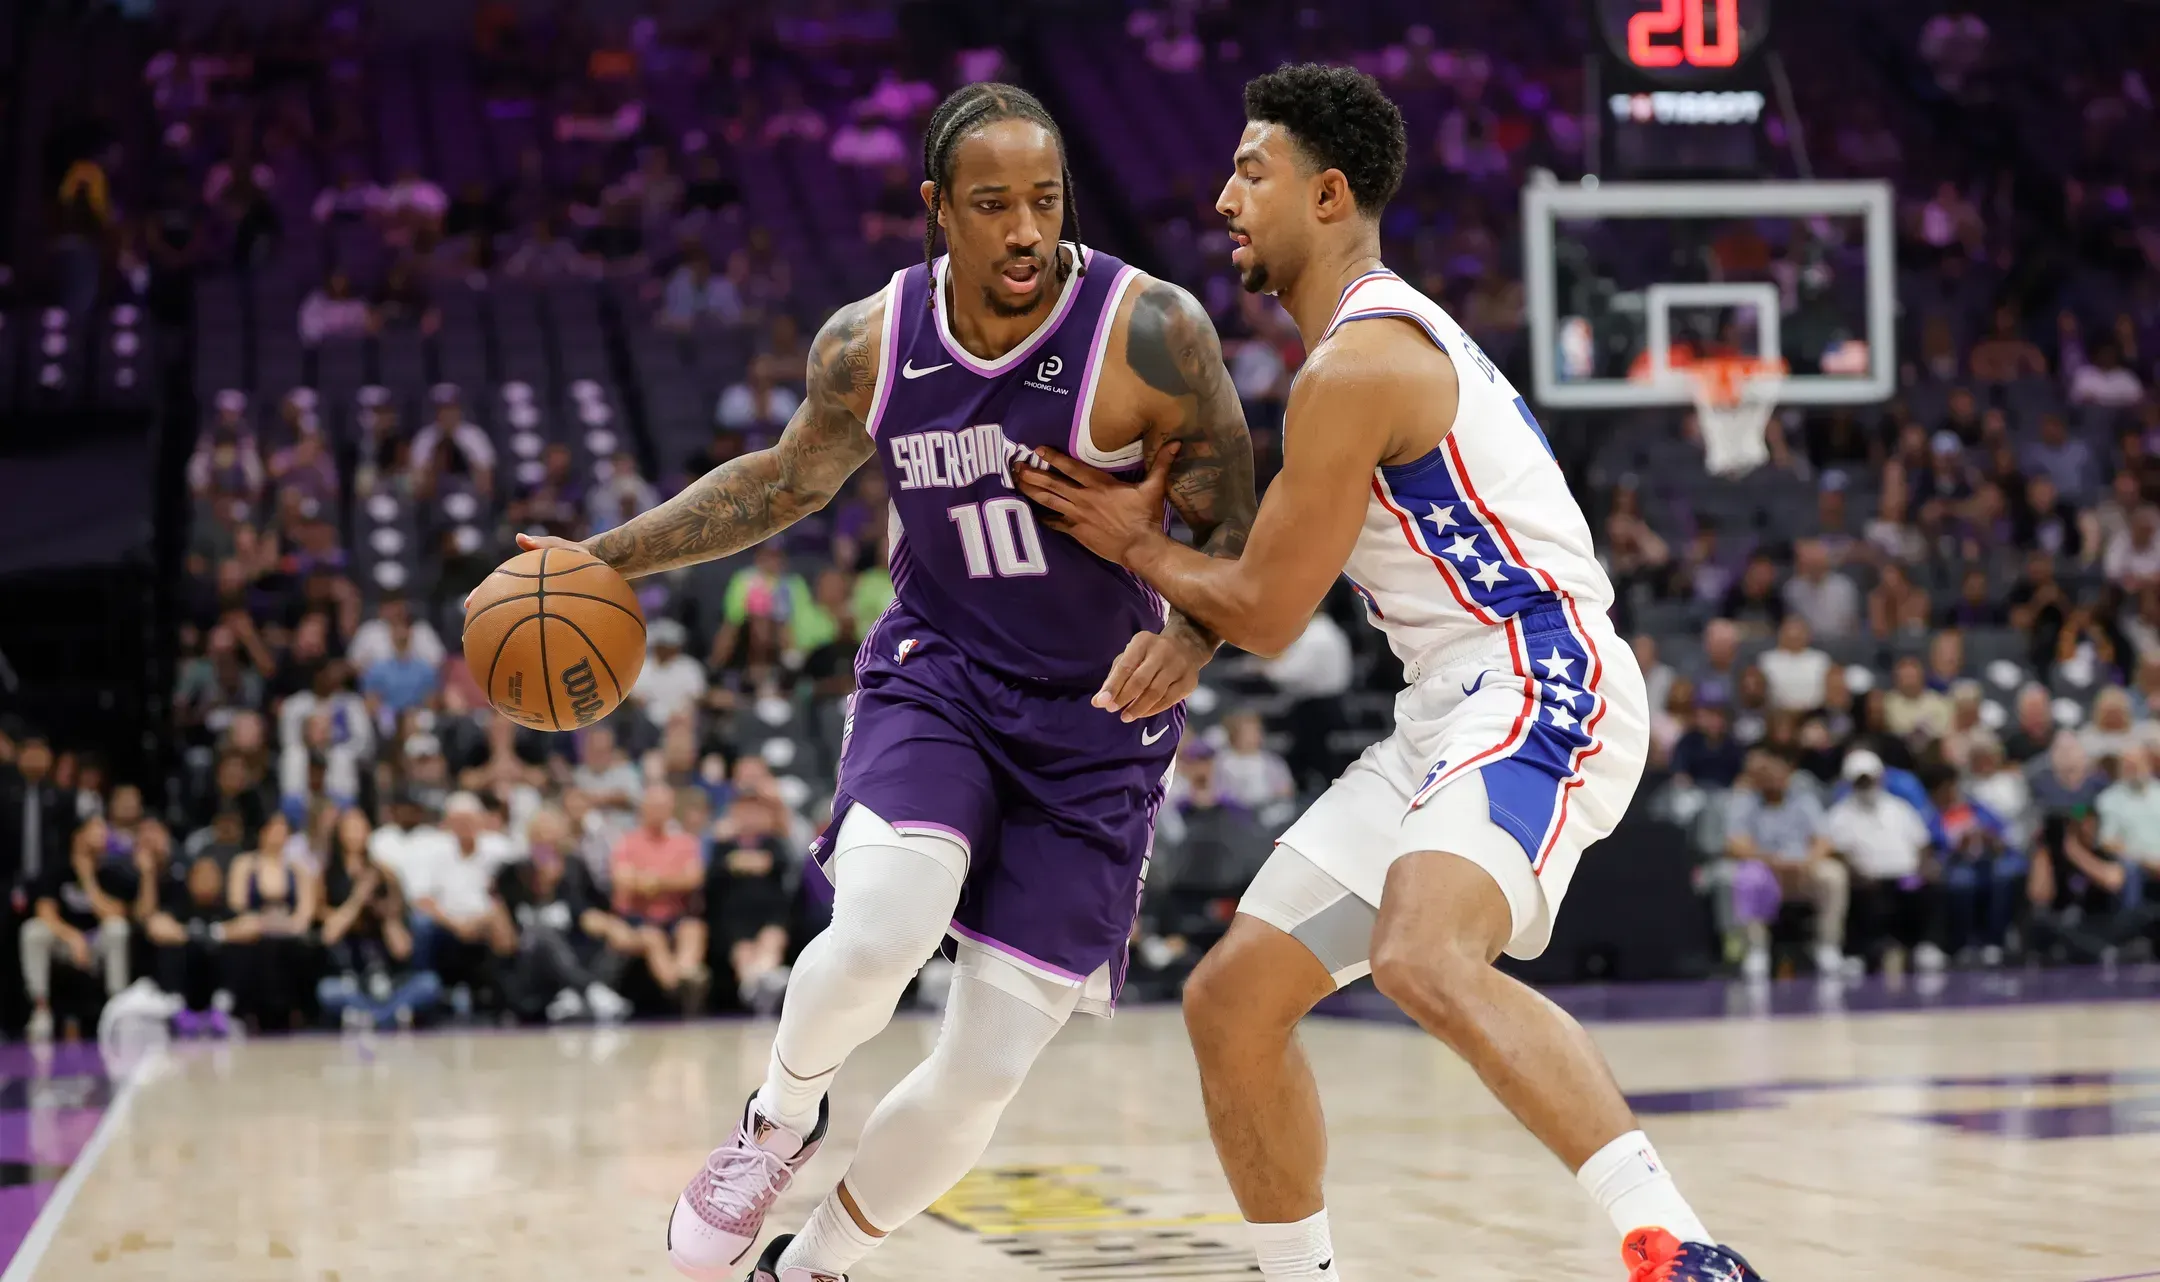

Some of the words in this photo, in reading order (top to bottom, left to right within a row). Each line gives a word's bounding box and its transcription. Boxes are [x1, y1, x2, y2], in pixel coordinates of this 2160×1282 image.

[1628, 0, 1739, 67] 20
[1024, 380, 1052, 391] PHOONG
[1052, 387, 1069, 395] LAW
[947, 496, 1049, 579] 10
